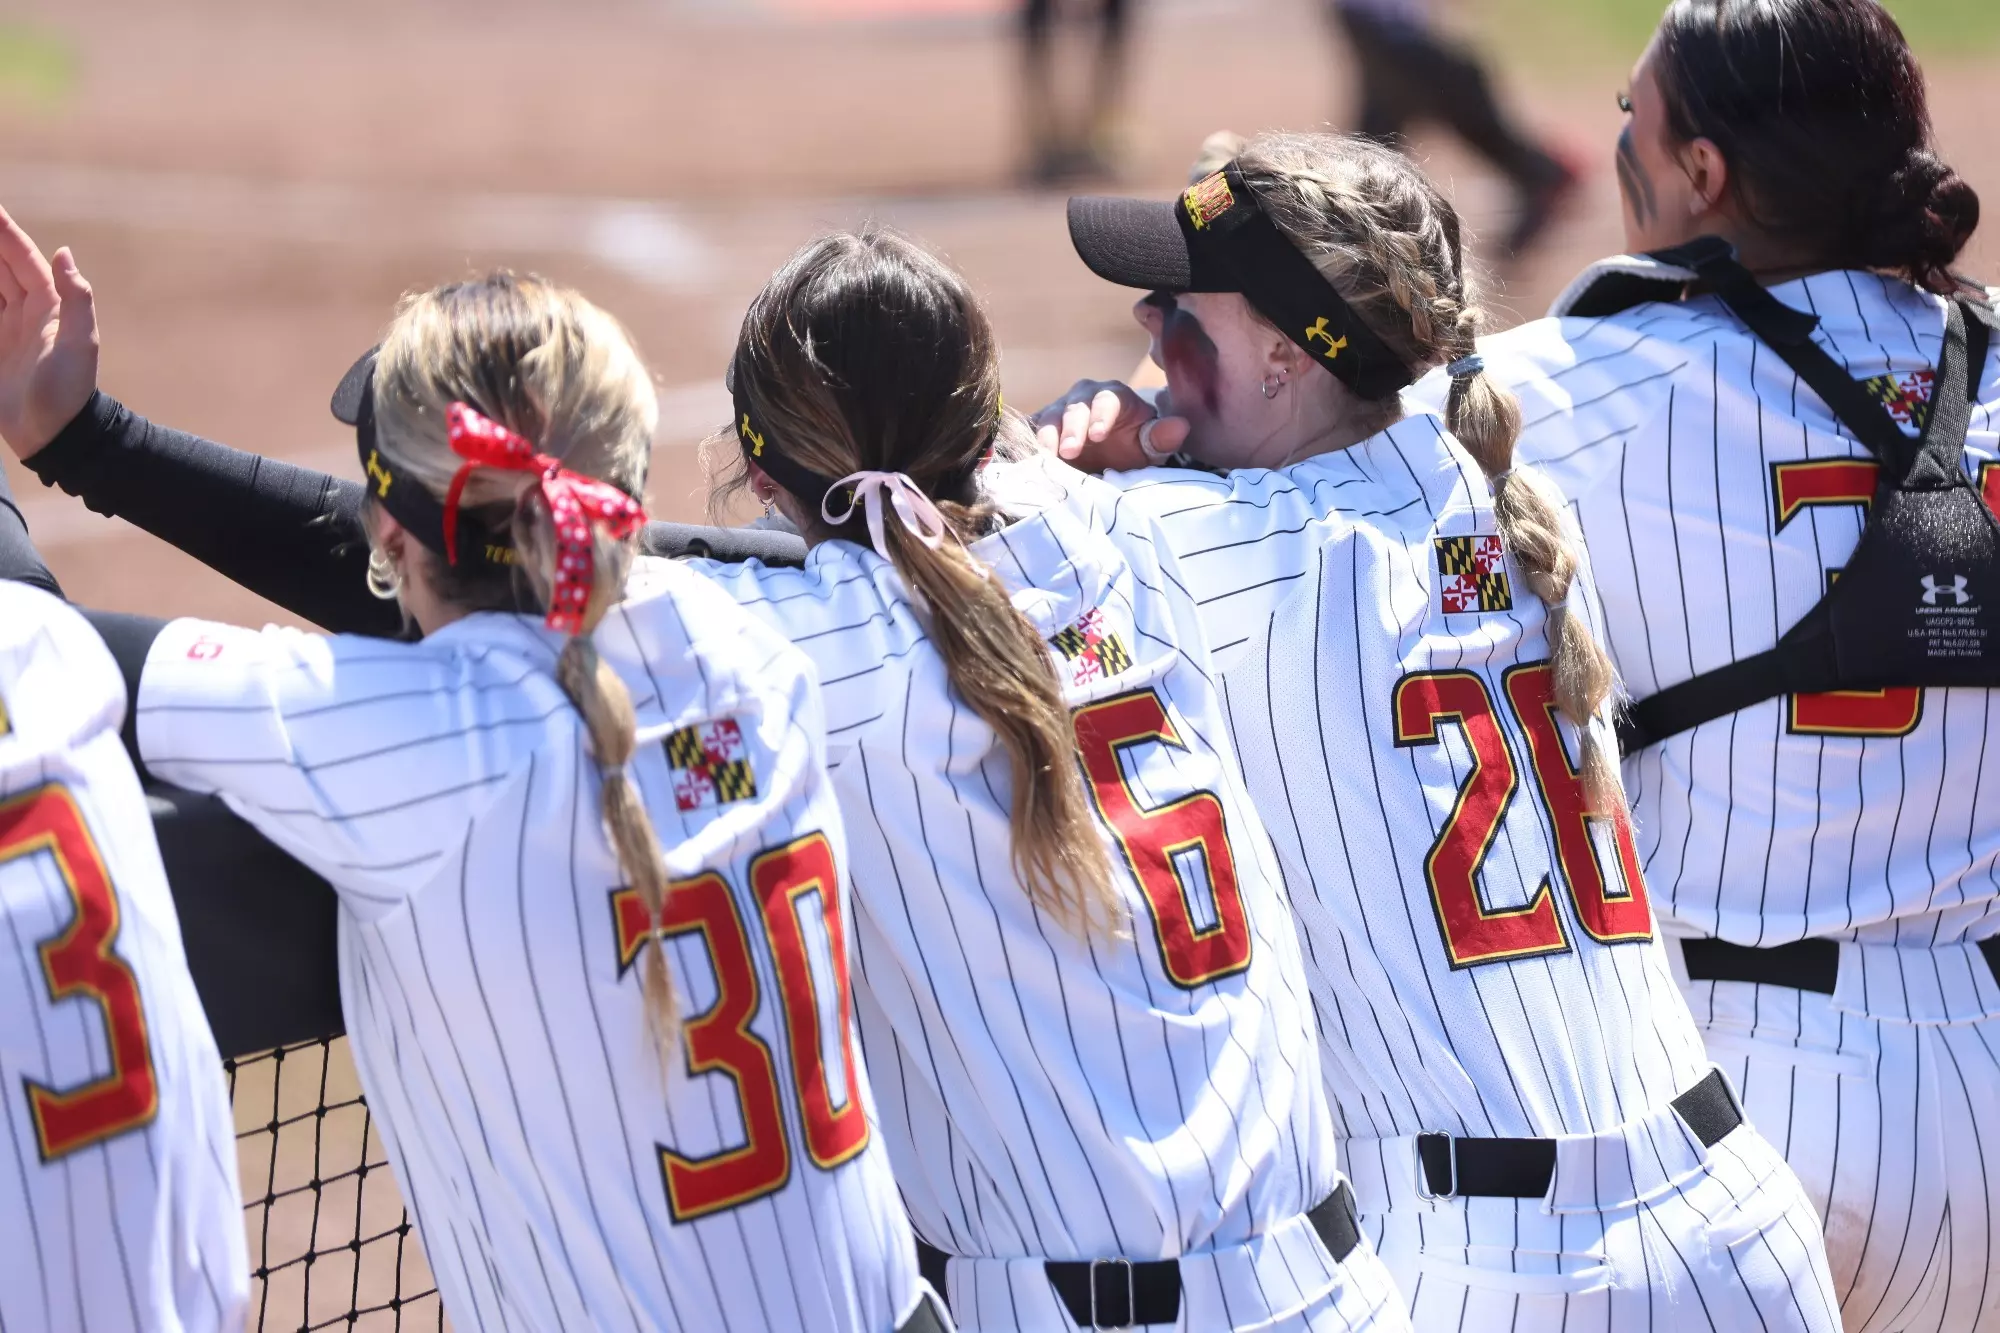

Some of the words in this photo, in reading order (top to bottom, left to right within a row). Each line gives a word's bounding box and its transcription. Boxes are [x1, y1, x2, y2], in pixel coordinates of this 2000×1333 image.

[1927, 649, 1947, 657] MADE
[1948, 649, 1956, 657] IN
[1957, 649, 1982, 657] TAIWAN
[1070, 687, 1252, 990] 6
[1391, 660, 1653, 971] 26
[608, 829, 870, 1226] 30
